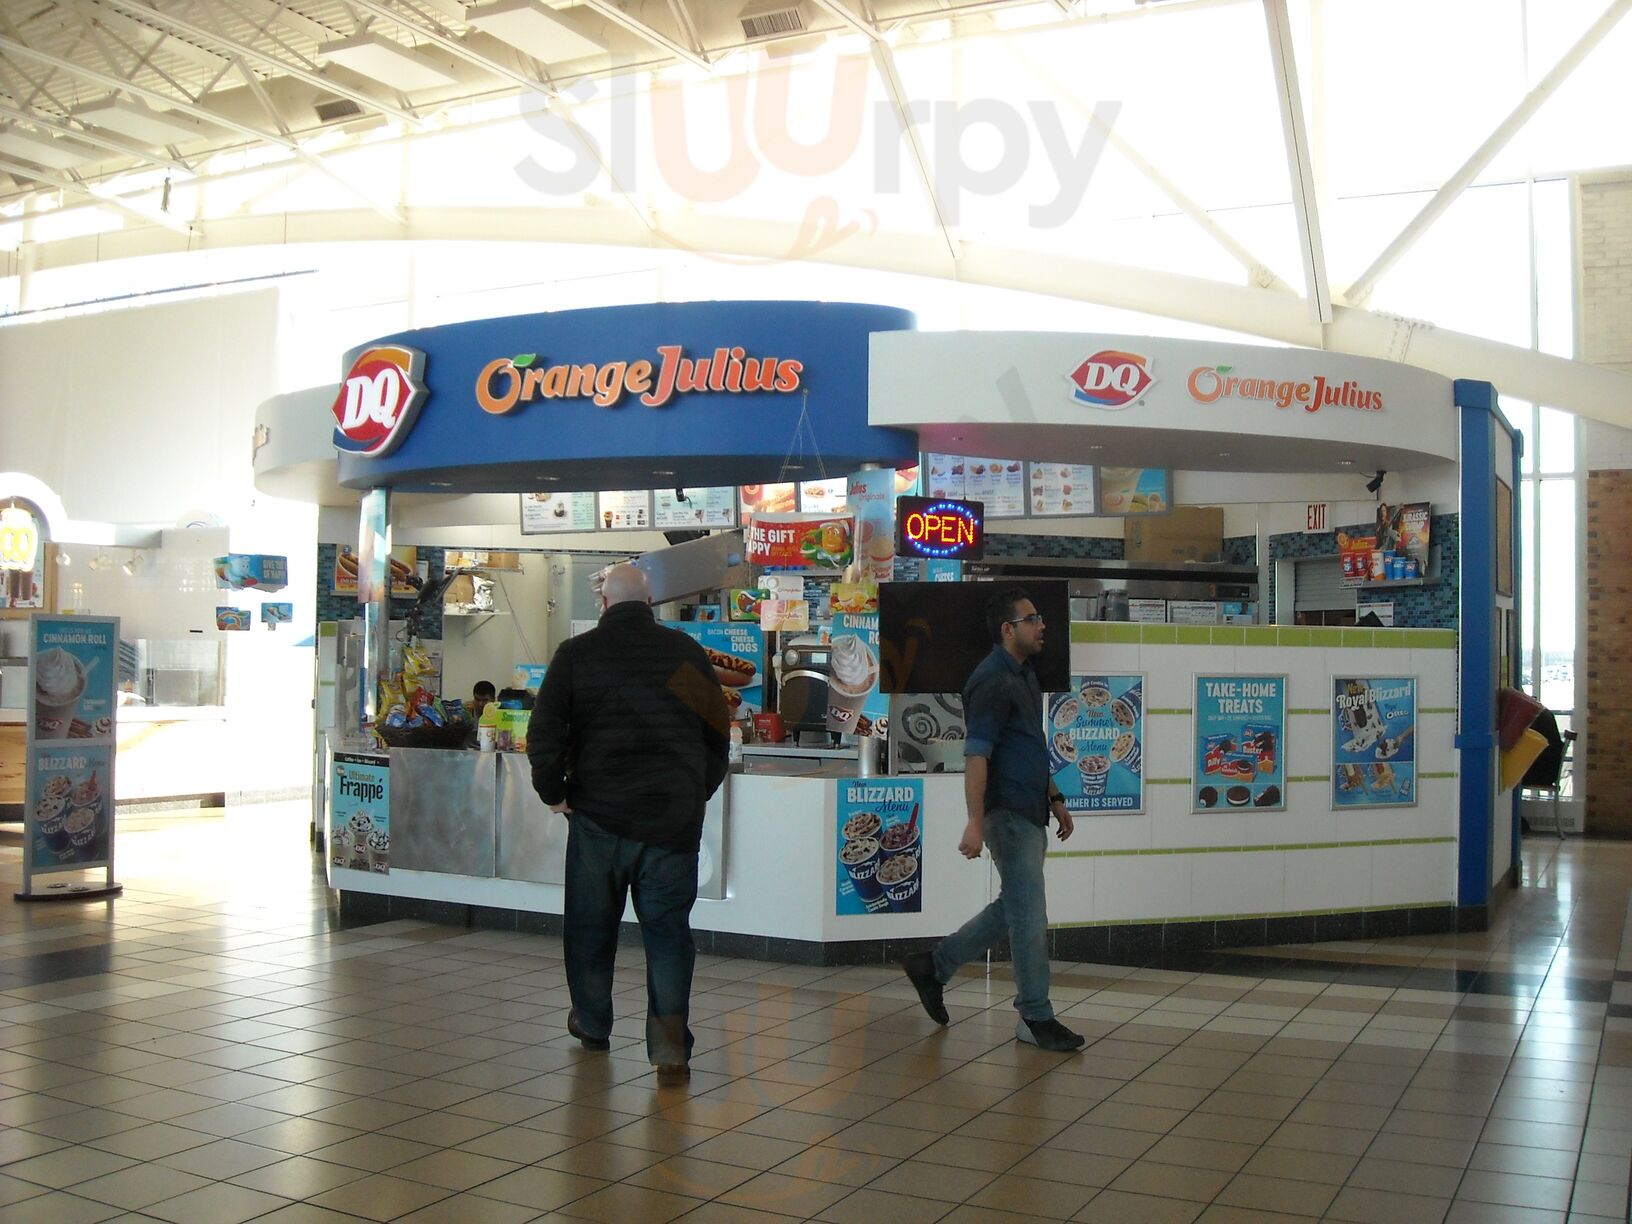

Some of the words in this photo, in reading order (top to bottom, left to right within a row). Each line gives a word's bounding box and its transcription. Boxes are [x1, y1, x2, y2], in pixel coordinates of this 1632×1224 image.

[1083, 362, 1141, 396] DQ
[342, 368, 398, 429] DQ
[1307, 504, 1327, 530] EXIT
[907, 513, 975, 544] OPEN
[768, 529, 795, 543] GIFT
[843, 615, 879, 630] CINNAM
[43, 633, 86, 645] CINNAMON
[88, 634, 107, 645] ROLL
[724, 628, 748, 636] CHEESE
[731, 635, 754, 643] CHEESE
[732, 643, 758, 653] DOGS
[1205, 682, 1276, 697] TAKE-HOME
[1336, 689, 1367, 712] Royal
[1368, 680, 1411, 704] Blizzard
[1218, 698, 1263, 713] TREATS
[1075, 715, 1115, 728] Summer
[1069, 727, 1120, 740] BLIZZARD
[1080, 740, 1108, 752] Menu
[38, 757, 86, 771] BLIZZARD
[340, 776, 384, 803] Frappé
[847, 787, 914, 802] BLIZZARD
[874, 800, 909, 813] Menu
[1064, 798, 1089, 808] MMER
[1091, 798, 1099, 807] IS
[1102, 797, 1133, 808] SERVED
